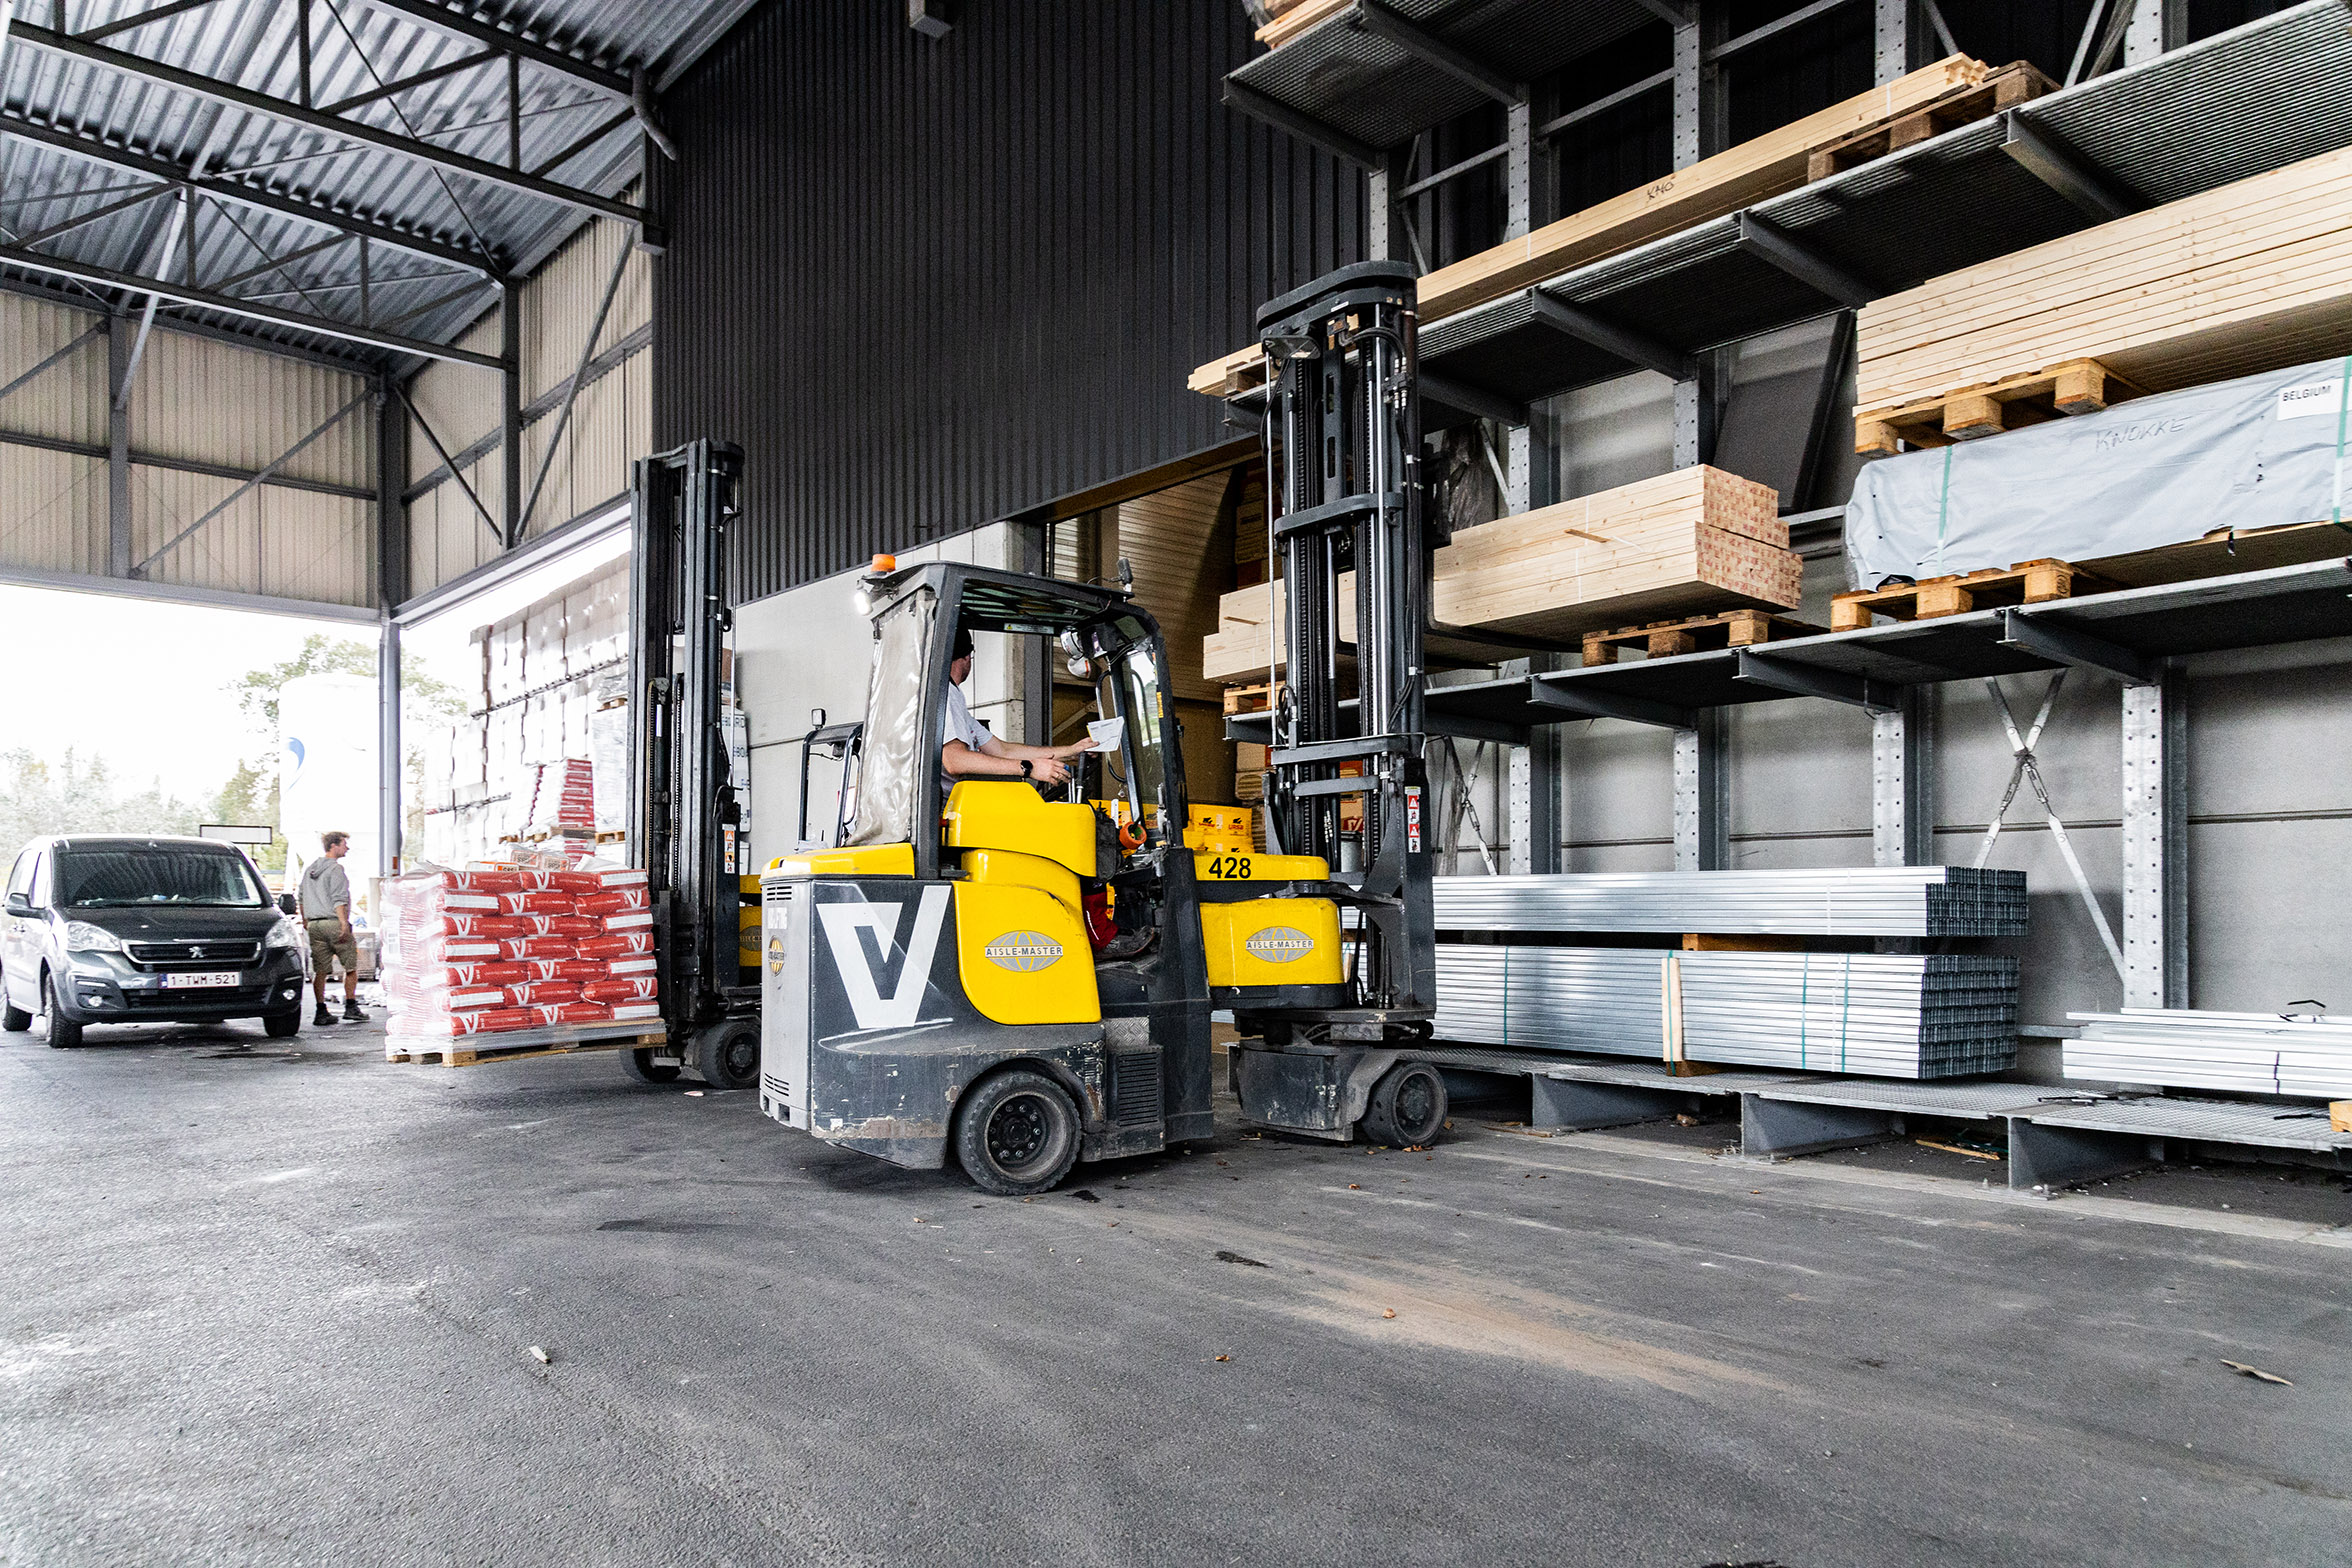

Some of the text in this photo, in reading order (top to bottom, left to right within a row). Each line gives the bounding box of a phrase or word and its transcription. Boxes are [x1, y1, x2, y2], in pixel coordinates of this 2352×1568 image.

[2282, 385, 2331, 402] BELGIUM
[1208, 857, 1251, 879] 428
[986, 946, 1063, 956] AISLE-MASTER
[1246, 940, 1313, 949] AISLE-MASTER
[815, 885, 952, 1029] V
[171, 974, 236, 985] 1-TWM-521
